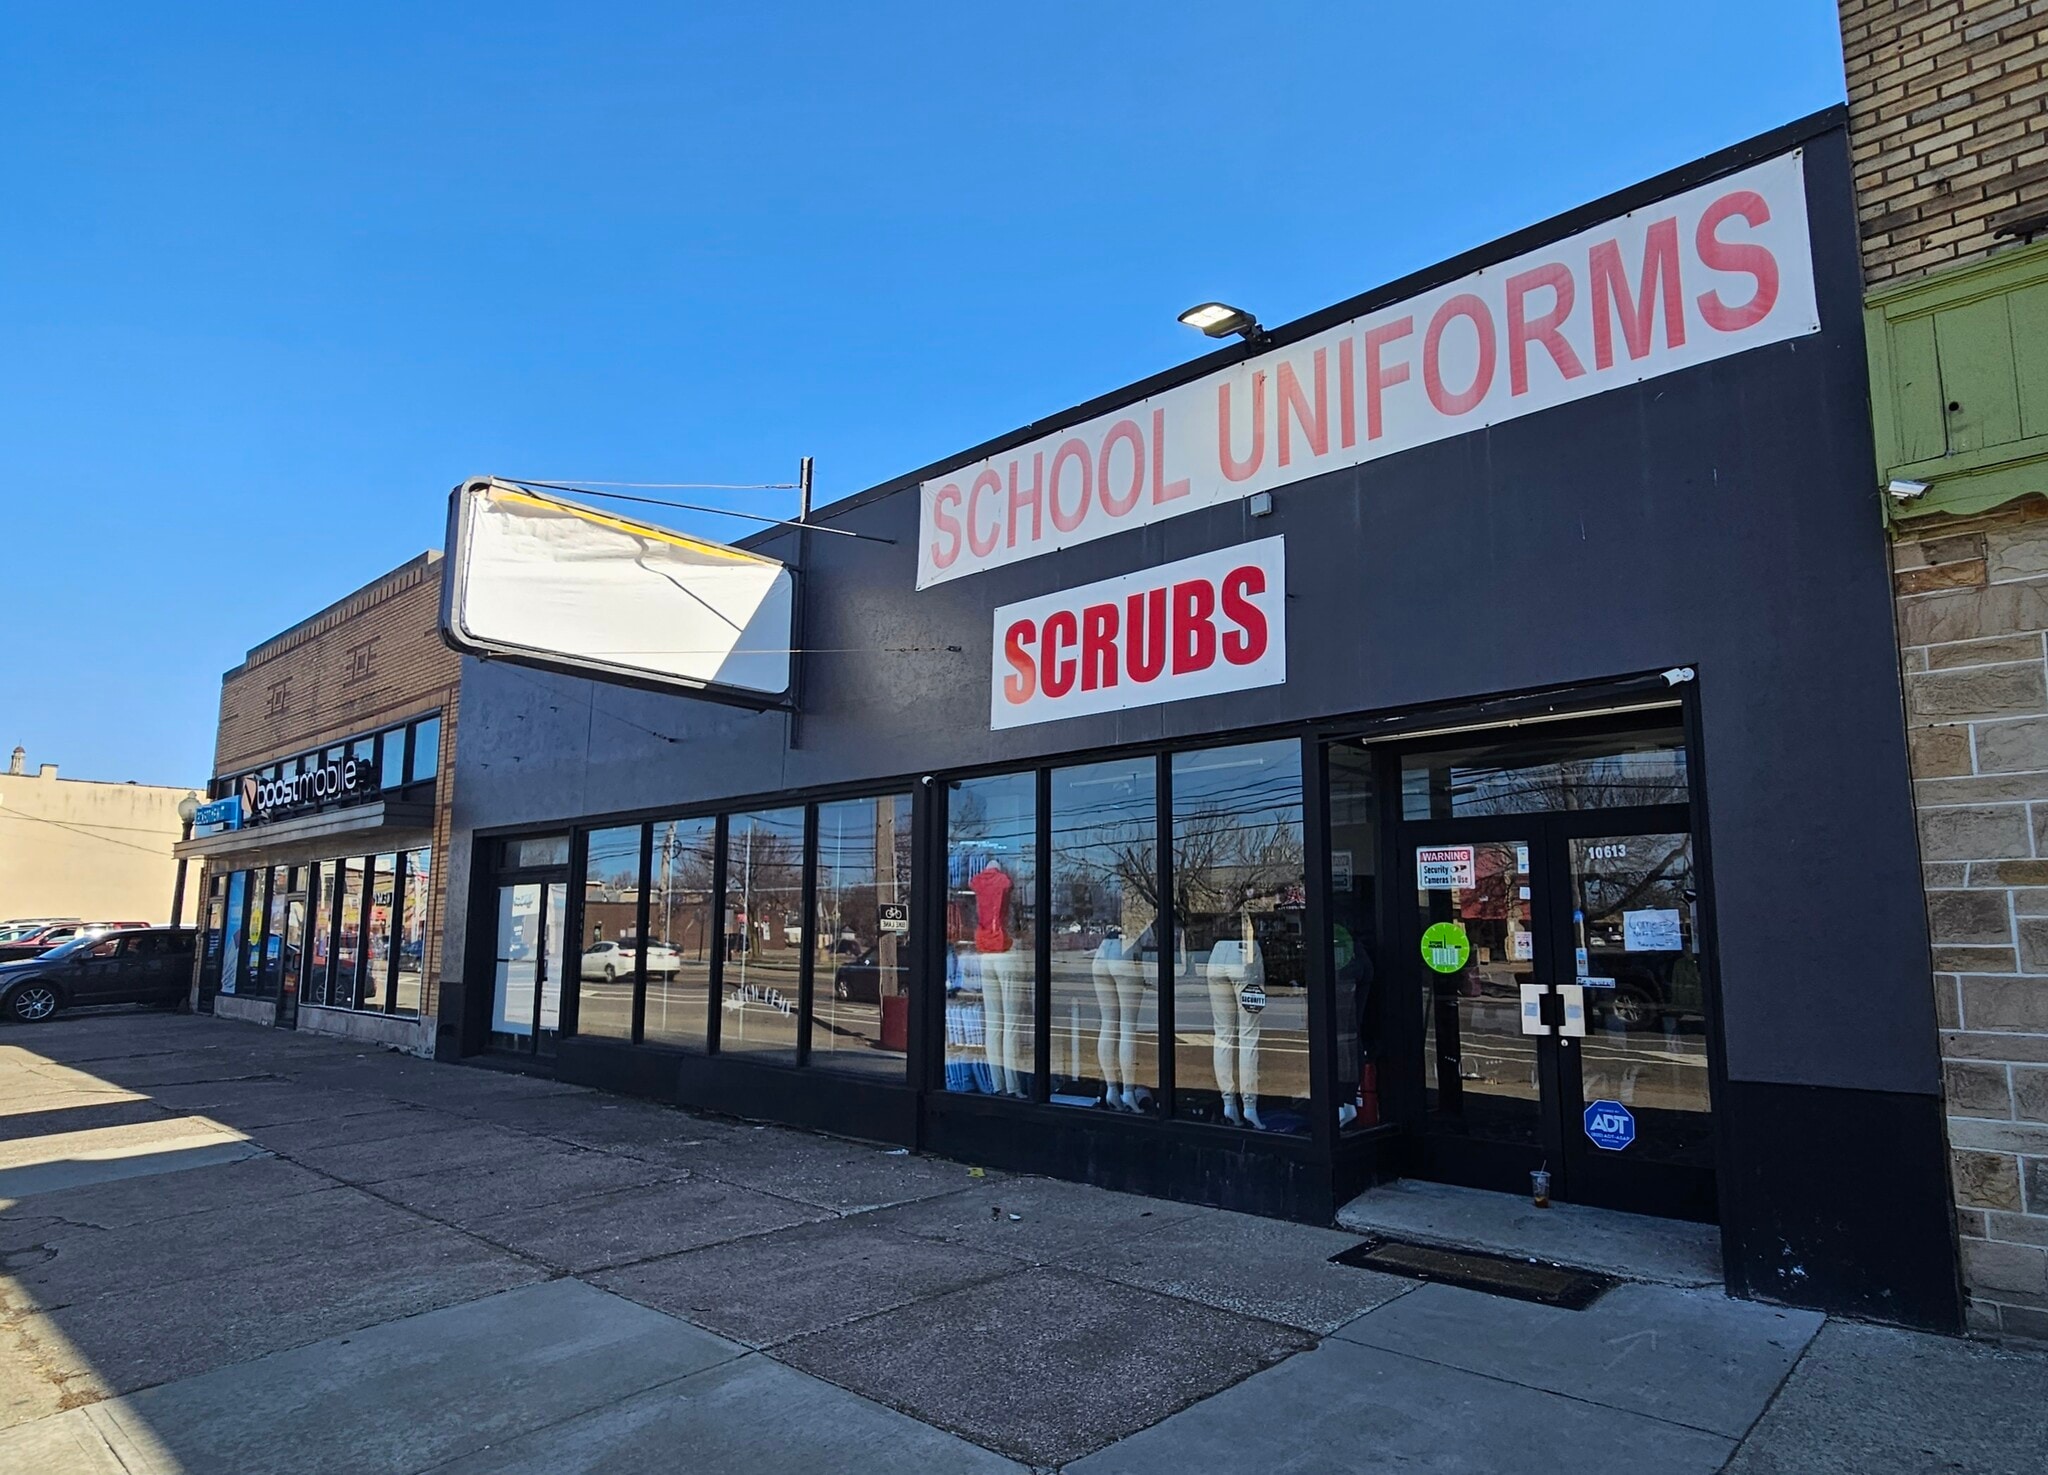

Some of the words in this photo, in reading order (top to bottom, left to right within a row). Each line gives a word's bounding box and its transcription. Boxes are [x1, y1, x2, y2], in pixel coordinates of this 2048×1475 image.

[931, 408, 1191, 569] SCHOOL
[1218, 190, 1779, 482] UNIFORMS
[1003, 564, 1269, 706] SCRUBS
[1421, 850, 1469, 862] WARNING
[1588, 844, 1626, 860] 10613
[1424, 865, 1449, 875] Security
[1424, 876, 1449, 884] Cameras
[1458, 875, 1468, 884] Use
[1590, 1113, 1629, 1134] ADT
